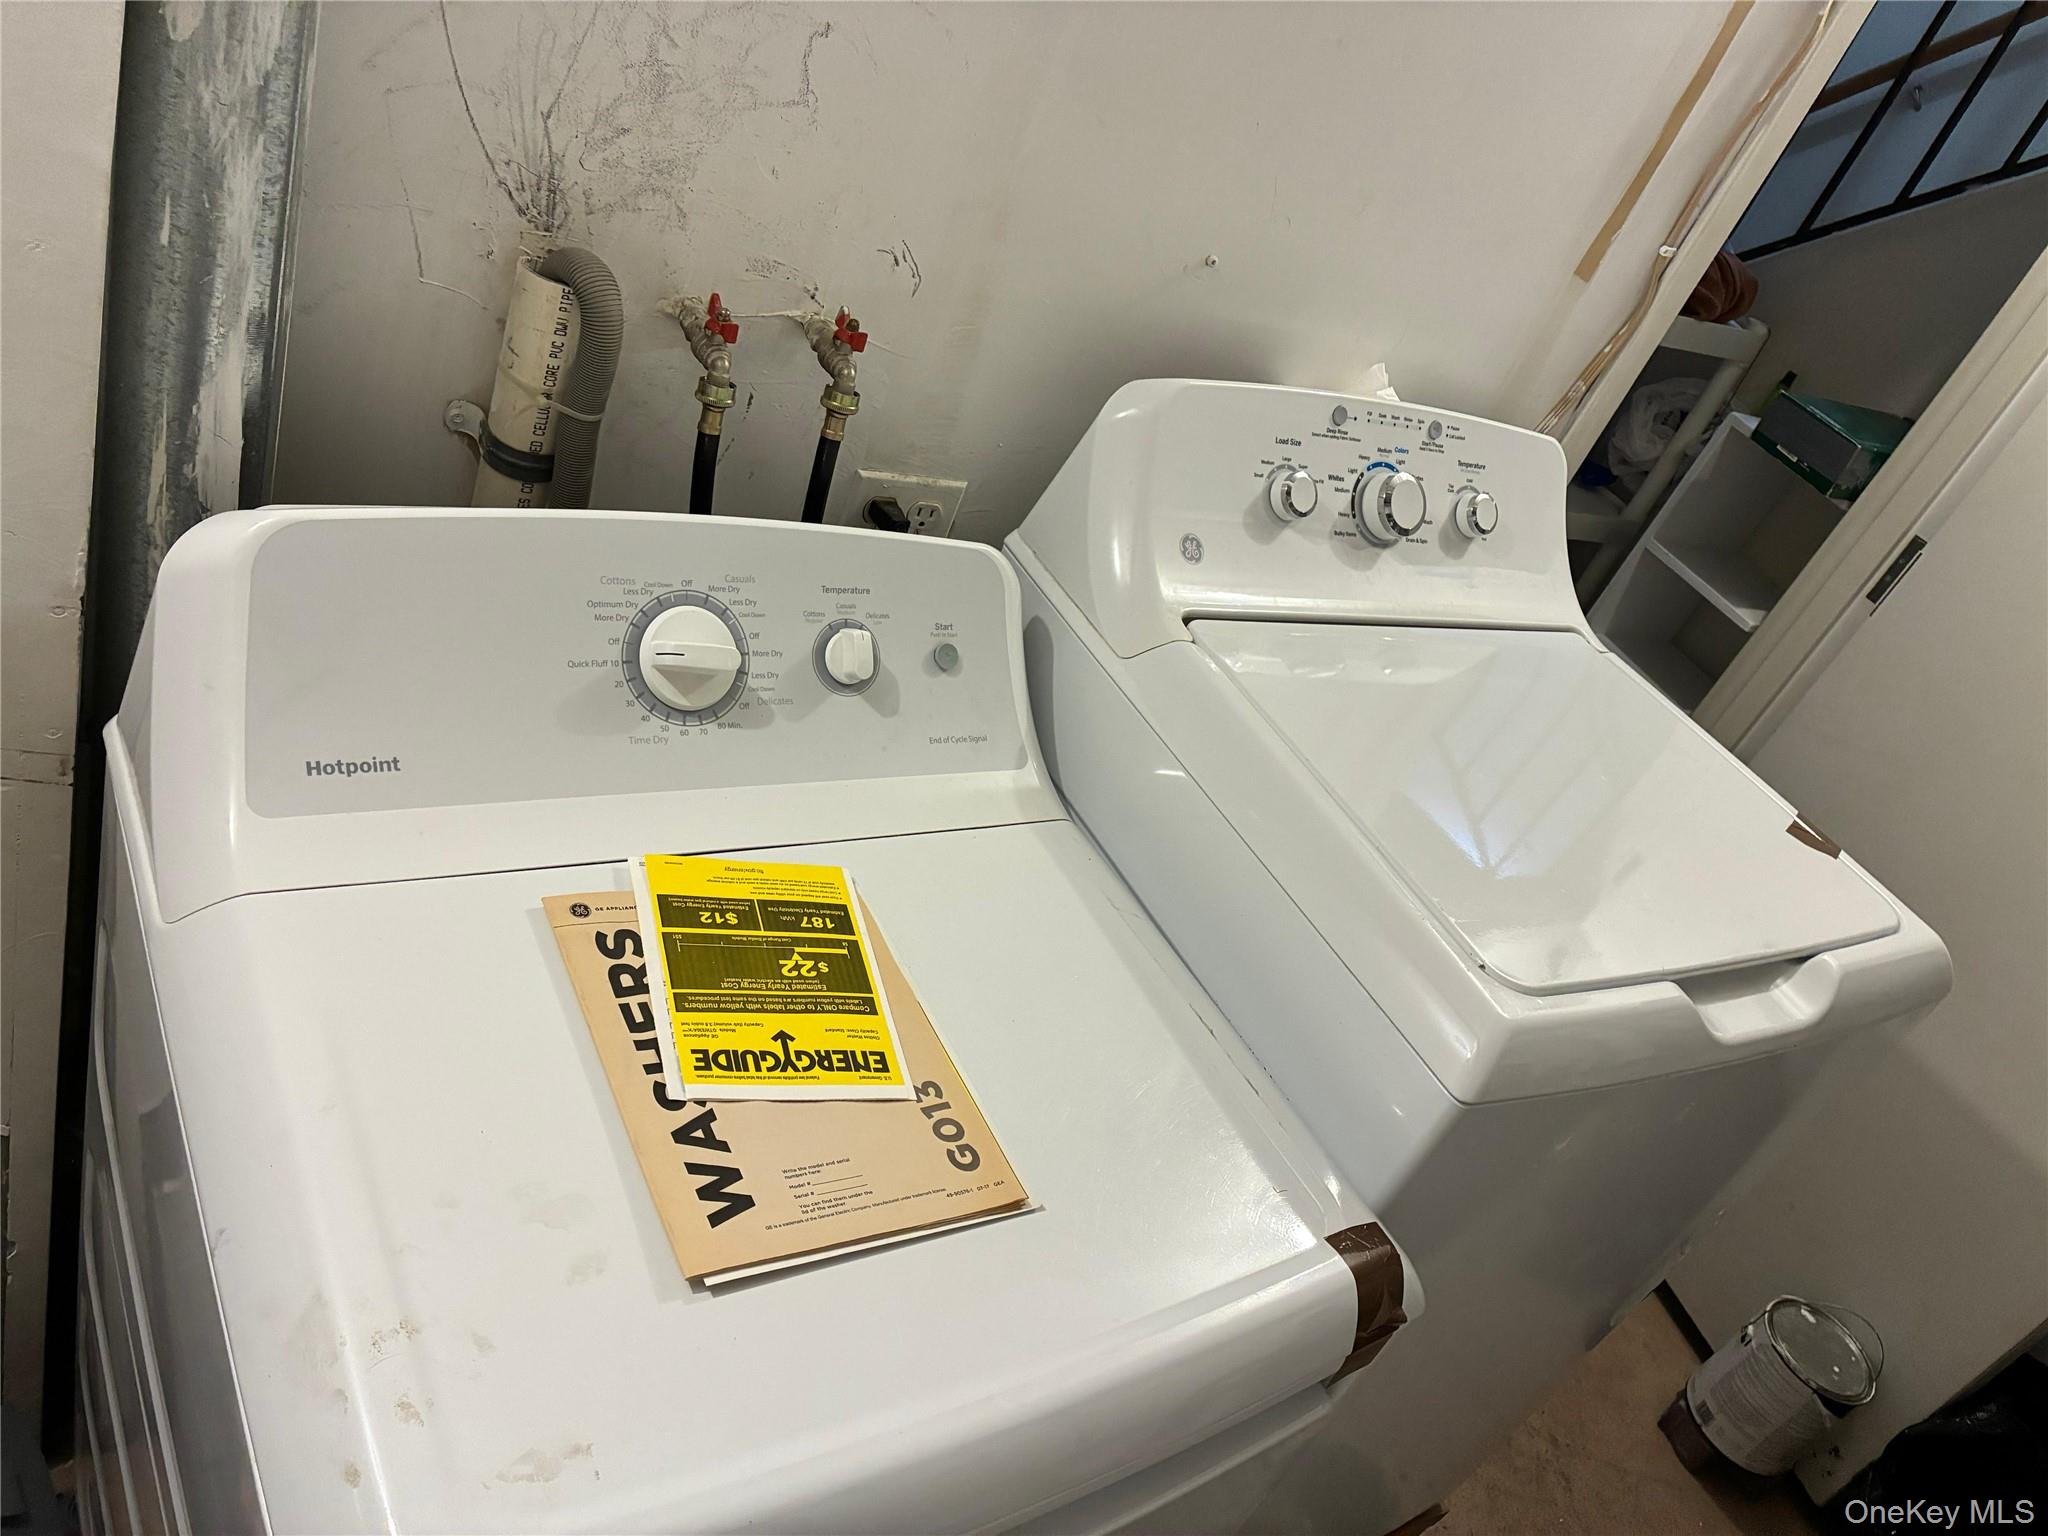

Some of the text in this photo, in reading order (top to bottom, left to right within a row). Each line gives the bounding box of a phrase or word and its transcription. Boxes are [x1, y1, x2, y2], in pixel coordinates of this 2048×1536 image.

[543, 363, 560, 389] CORE
[1275, 436, 1302, 447] Load Size
[1394, 446, 1409, 455] Colors
[1457, 460, 1486, 471] Temperature
[1347, 467, 1358, 475] Light
[1328, 474, 1345, 483] Whites
[600, 576, 637, 586] Cottons
[681, 579, 693, 588] Off
[724, 574, 756, 584] Casuals
[623, 587, 655, 597] Less Dry
[708, 584, 741, 595] More Dry
[821, 585, 871, 597] Temperature
[586, 600, 639, 611] Optimum Dry
[729, 598, 758, 608] Less Dry
[594, 613, 630, 623] More Dry
[803, 610, 826, 618] Cottons
[934, 623, 953, 632] Start
[749, 631, 761, 640] Off
[608, 637, 620, 646] Off
[752, 650, 784, 660] More Dry
[567, 659, 620, 669] Quick Fluff 10
[752, 671, 780, 682] Less Dry
[614, 680, 624, 688] 20
[626, 700, 635, 708] 30
[739, 702, 750, 711] Off
[757, 696, 794, 707] Delicates
[641, 715, 650, 723] 40
[660, 725, 670, 733] 50
[717, 721, 744, 731] 80 Min.
[679, 729, 689, 737] 60
[700, 728, 709, 736] 70
[628, 735, 669, 746] Time Dry
[929, 735, 988, 746] End of Cycle Signal
[305, 756, 401, 778] Hotpoint
[672, 901, 686, 909] Cost
[687, 901, 706, 910] Energy
[722, 904, 750, 912] Estimated
[768, 905, 778, 913] Use
[778, 906, 804, 915] Electricity
[819, 909, 845, 917] Estimated
[698, 911, 740, 927] $12
[800, 915, 837, 930] 187
[778, 959, 830, 978] $22
[720, 981, 828, 991] Estimated Yearly Energy Cost
[681, 1001, 871, 1013] Compare ONLY to other labels with yellow numbers.
[690, 1047, 892, 1074] ENERGYGUIDE
[781, 1157, 851, 1175] Write the model and serial
[784, 1171, 808, 1180] numbers
[789, 1181, 806, 1190] Model
[793, 1191, 810, 1200] Serial
[799, 1189, 874, 1210] You can find them under the
[816, 1205, 827, 1213] the
